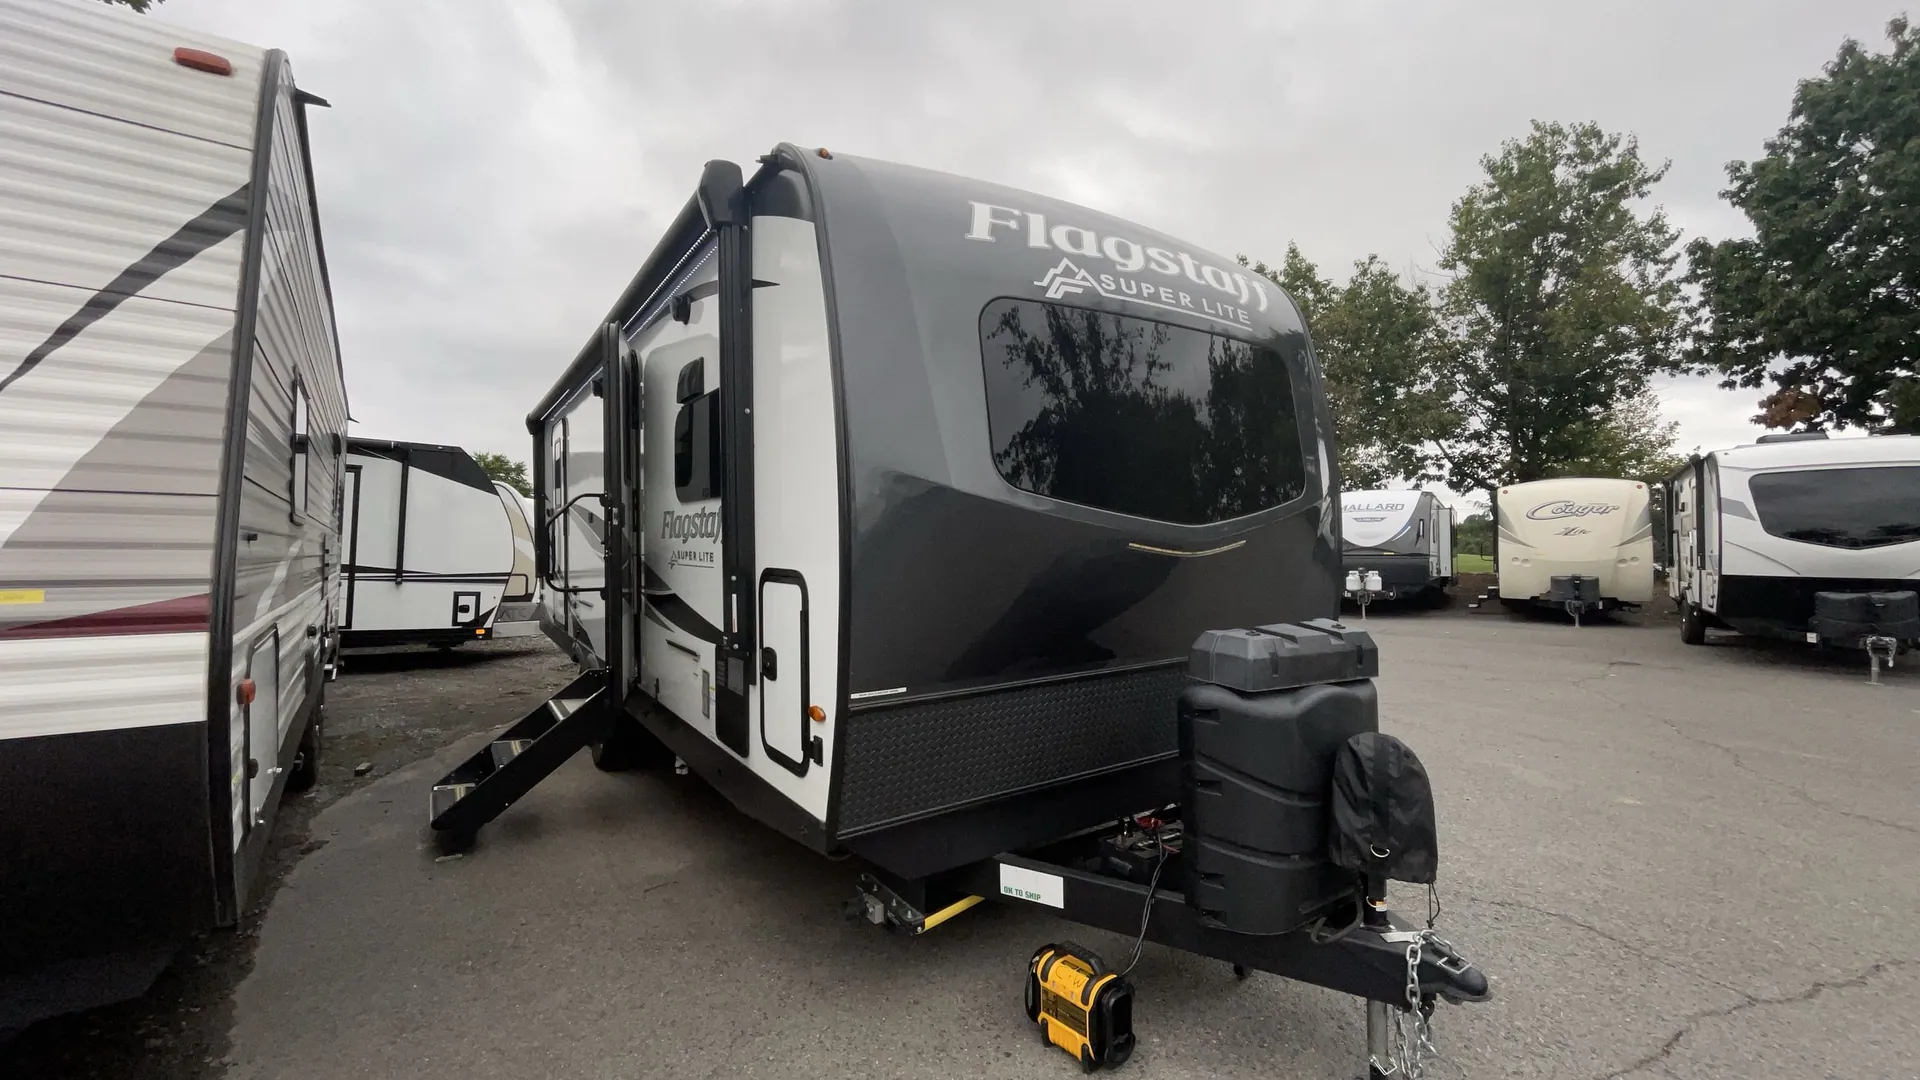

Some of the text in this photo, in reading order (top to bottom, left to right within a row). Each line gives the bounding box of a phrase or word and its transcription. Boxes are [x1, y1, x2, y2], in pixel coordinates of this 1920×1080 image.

[964, 200, 1268, 313] Flagstaff
[1100, 274, 1250, 325] SUPER LITE
[1526, 500, 1620, 520] Cougar
[661, 506, 723, 544] Flagstaf
[677, 550, 715, 563] SUPER LITE
[1003, 885, 1042, 901] OK TO SHIP
